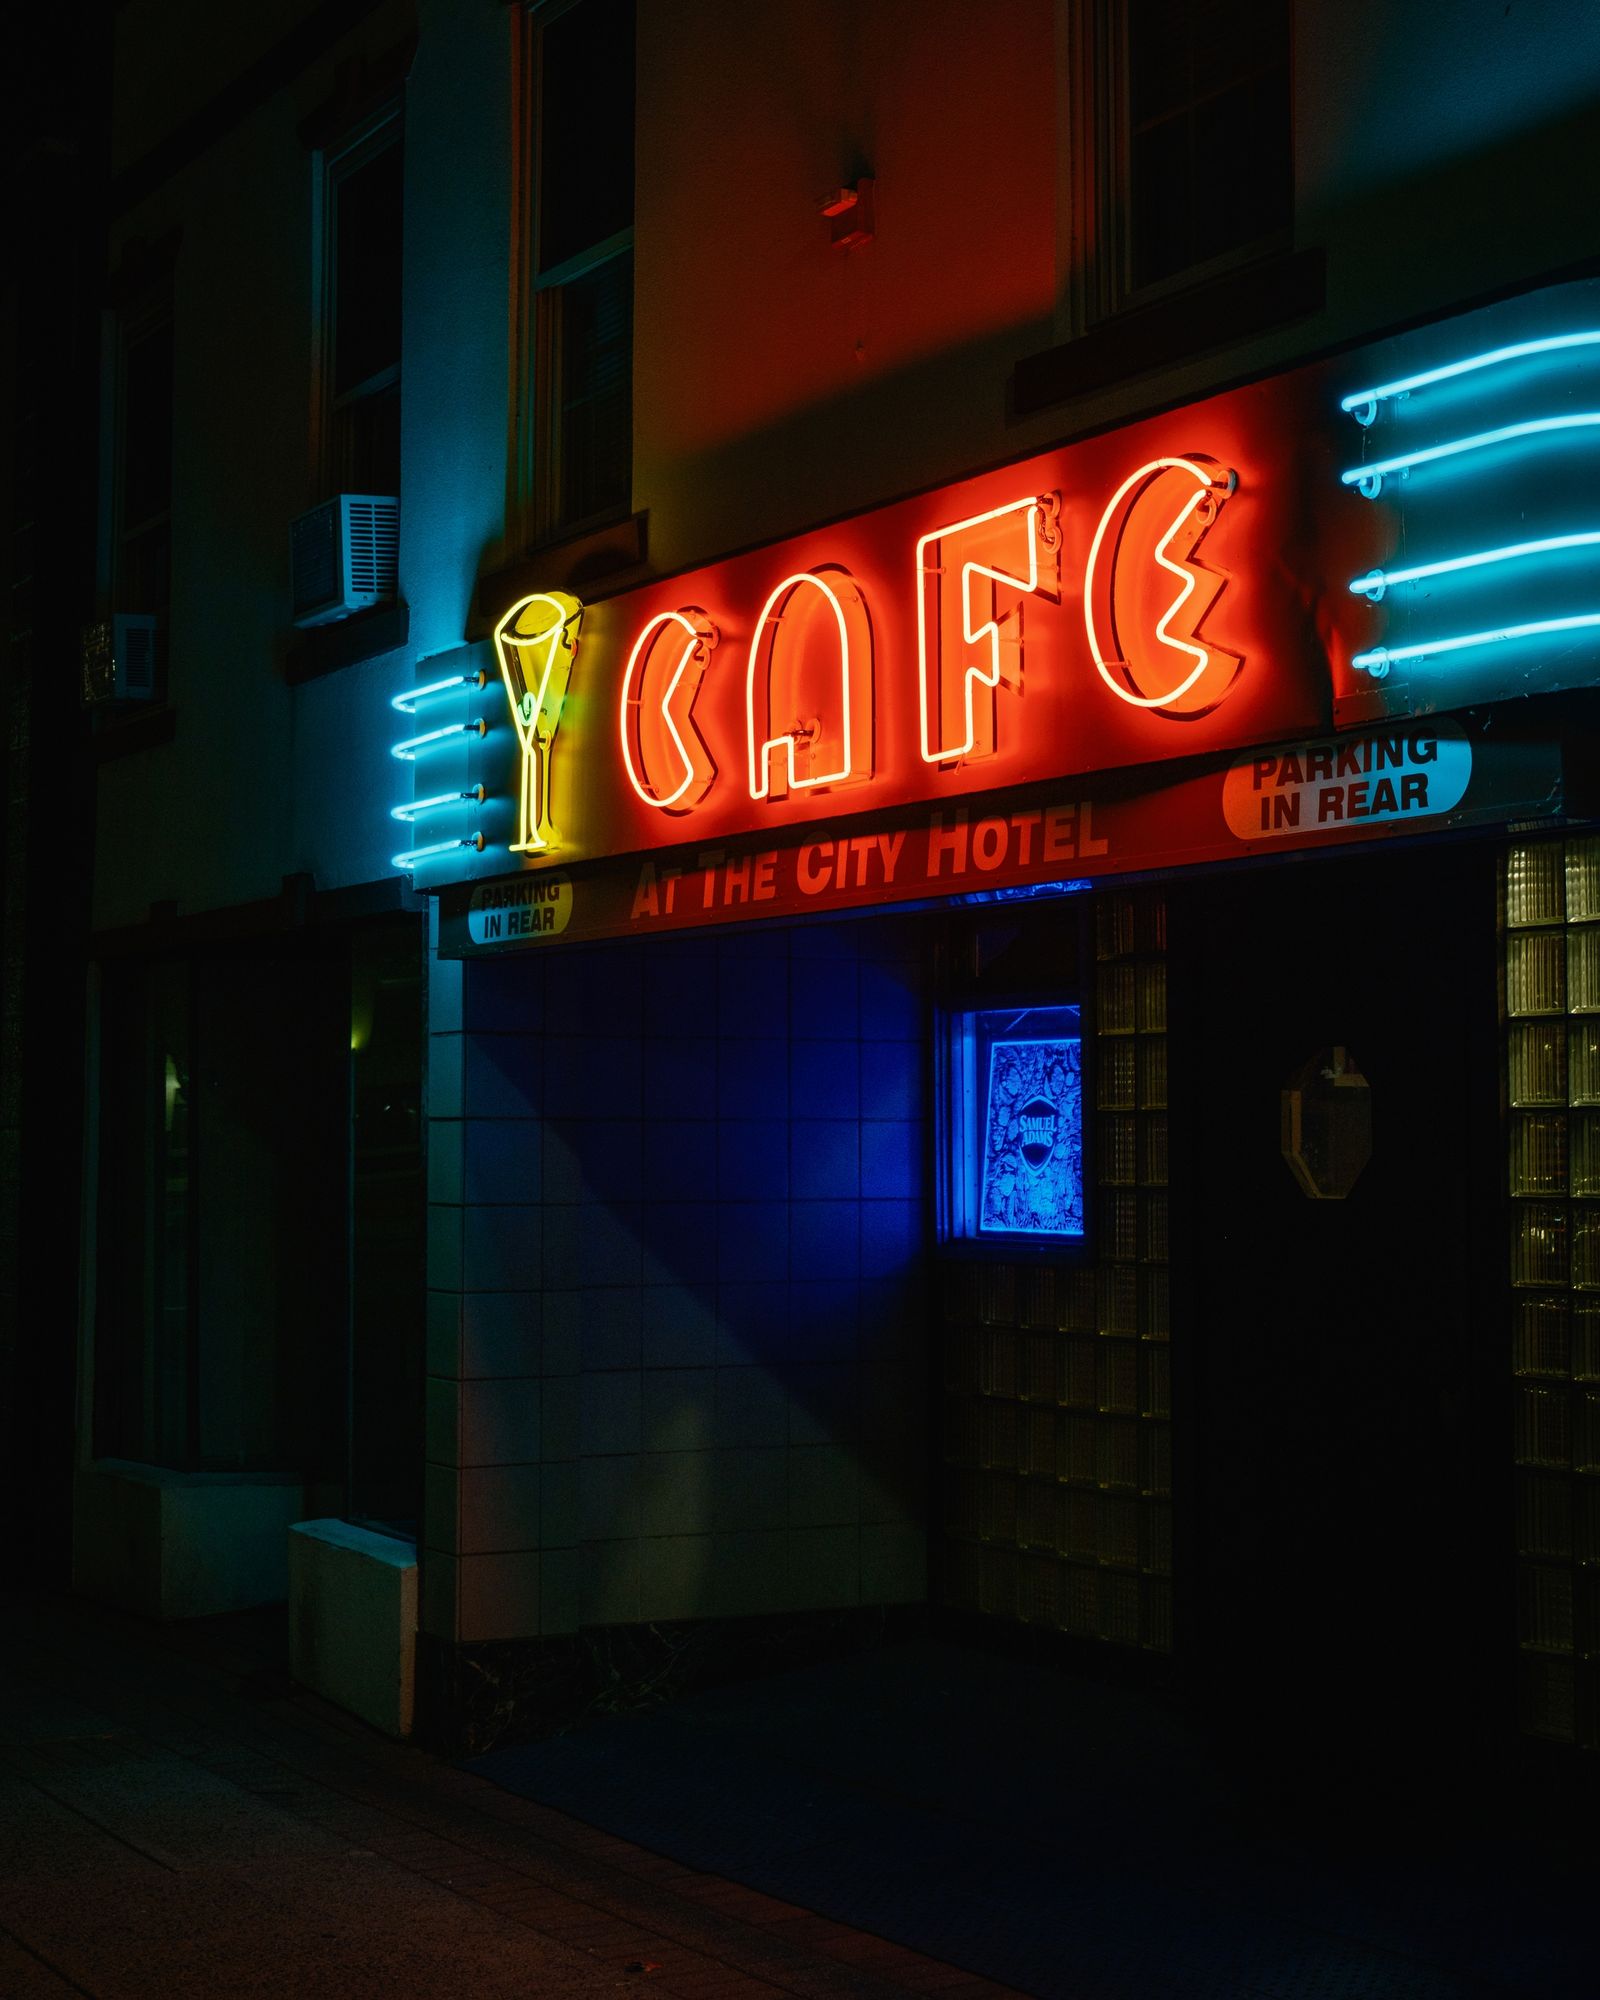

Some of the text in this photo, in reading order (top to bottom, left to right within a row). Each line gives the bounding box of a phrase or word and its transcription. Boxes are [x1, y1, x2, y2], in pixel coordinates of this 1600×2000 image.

[620, 455, 1245, 814] CAFE
[1253, 727, 1438, 791] PARKING
[1260, 772, 1429, 831] IN REAR
[630, 801, 1109, 919] AT THE CITY HOTEL
[480, 877, 561, 911] PARKING
[484, 906, 556, 939] IN REAR
[1019, 1114, 1058, 1132] SAMUEL
[1021, 1129, 1054, 1148] ADAMS
